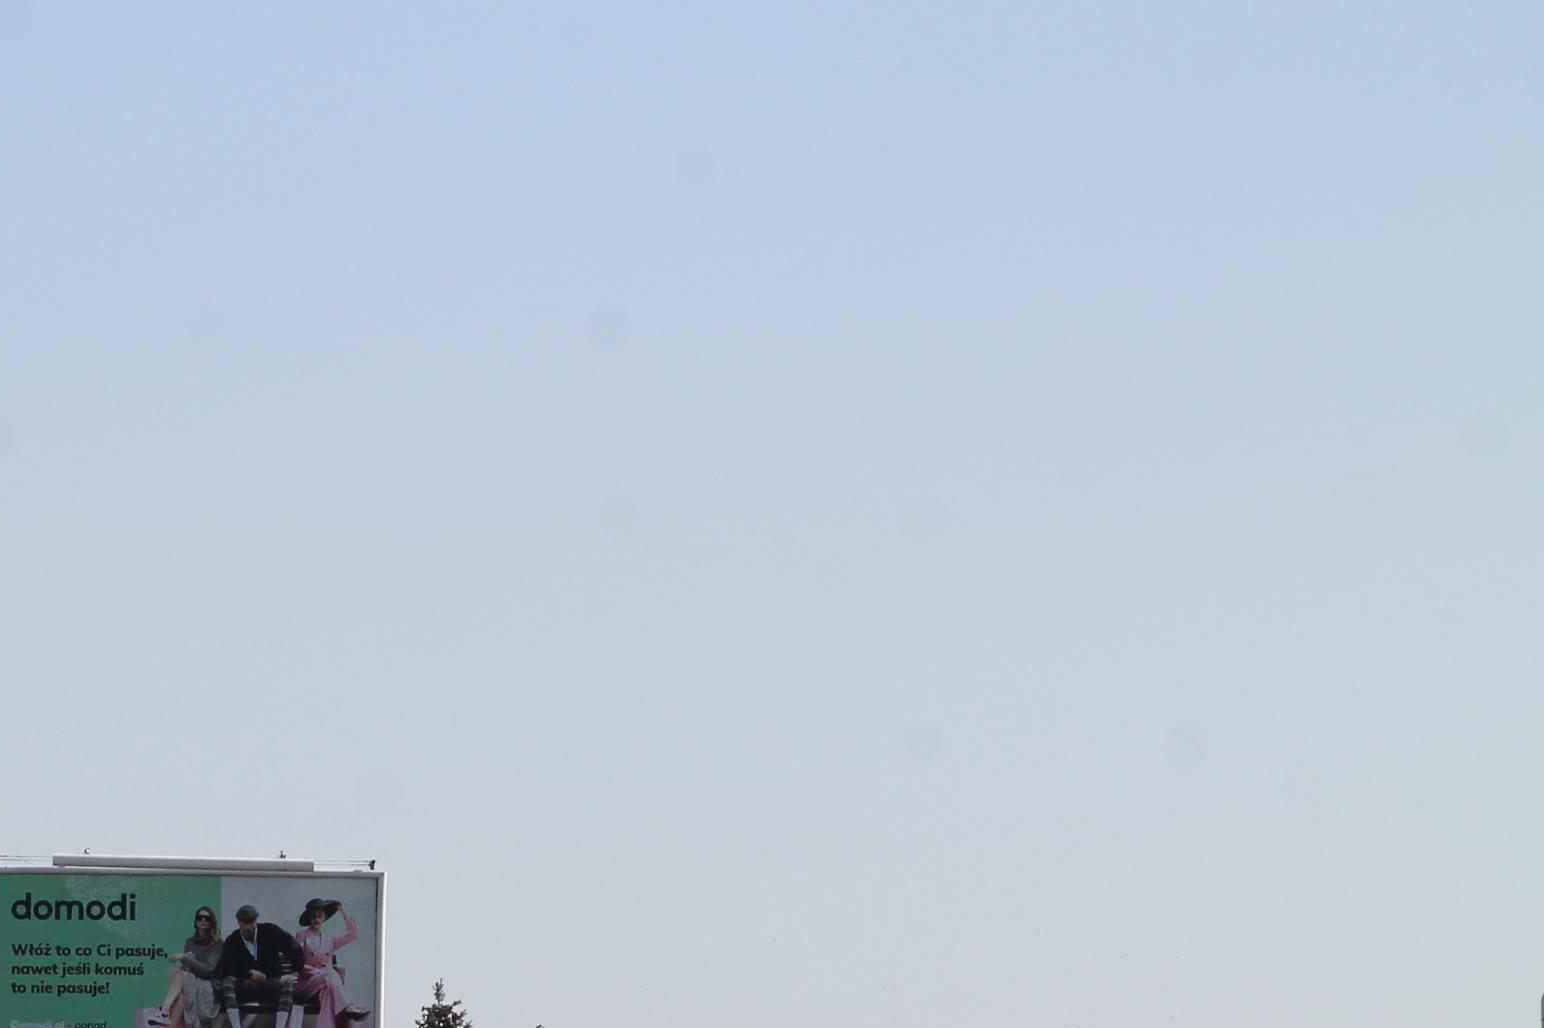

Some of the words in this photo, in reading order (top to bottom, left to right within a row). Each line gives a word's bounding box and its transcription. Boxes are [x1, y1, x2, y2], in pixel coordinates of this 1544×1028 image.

[11, 892, 136, 921] domodi
[12, 943, 51, 957] Włóż
[56, 945, 71, 957] to
[75, 946, 92, 957] co
[97, 944, 111, 957] Ci
[115, 944, 168, 960] pasuje,
[11, 964, 58, 976] nawet
[61, 962, 90, 978] jeśli
[95, 962, 144, 976] komuś
[11, 982, 26, 994] to
[31, 981, 53, 994] nie
[57, 981, 110, 997] pasuje!
